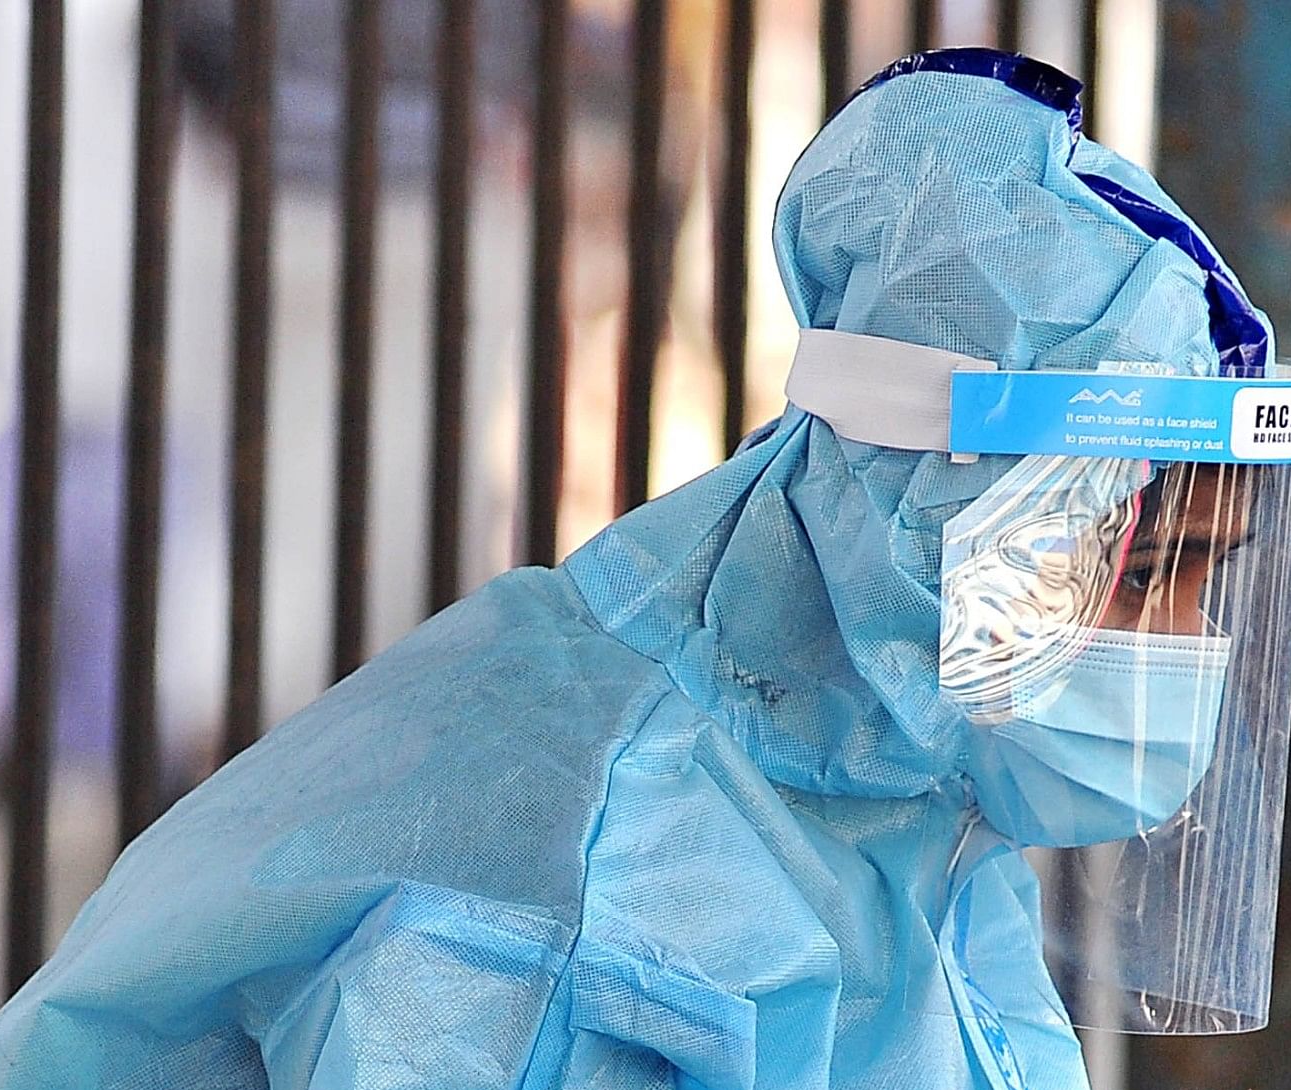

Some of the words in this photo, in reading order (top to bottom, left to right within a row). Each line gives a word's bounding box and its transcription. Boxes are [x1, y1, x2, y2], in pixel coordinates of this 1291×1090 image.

[1076, 414, 1096, 424] can
[1098, 414, 1112, 424] be
[1114, 415, 1140, 425] used
[1142, 417, 1155, 426] as
[1157, 418, 1164, 427] a
[1166, 416, 1188, 428] face
[1190, 418, 1217, 429] shield
[1065, 433, 1076, 443] to
[1078, 435, 1118, 446] prevent
[1120, 435, 1142, 446] fluid
[1144, 437, 1190, 450] splashing
[1192, 439, 1202, 449] or
[1204, 439, 1224, 449] dust
[1253, 432, 1266, 443] HD
[1267, 432, 1286, 443] FACE
